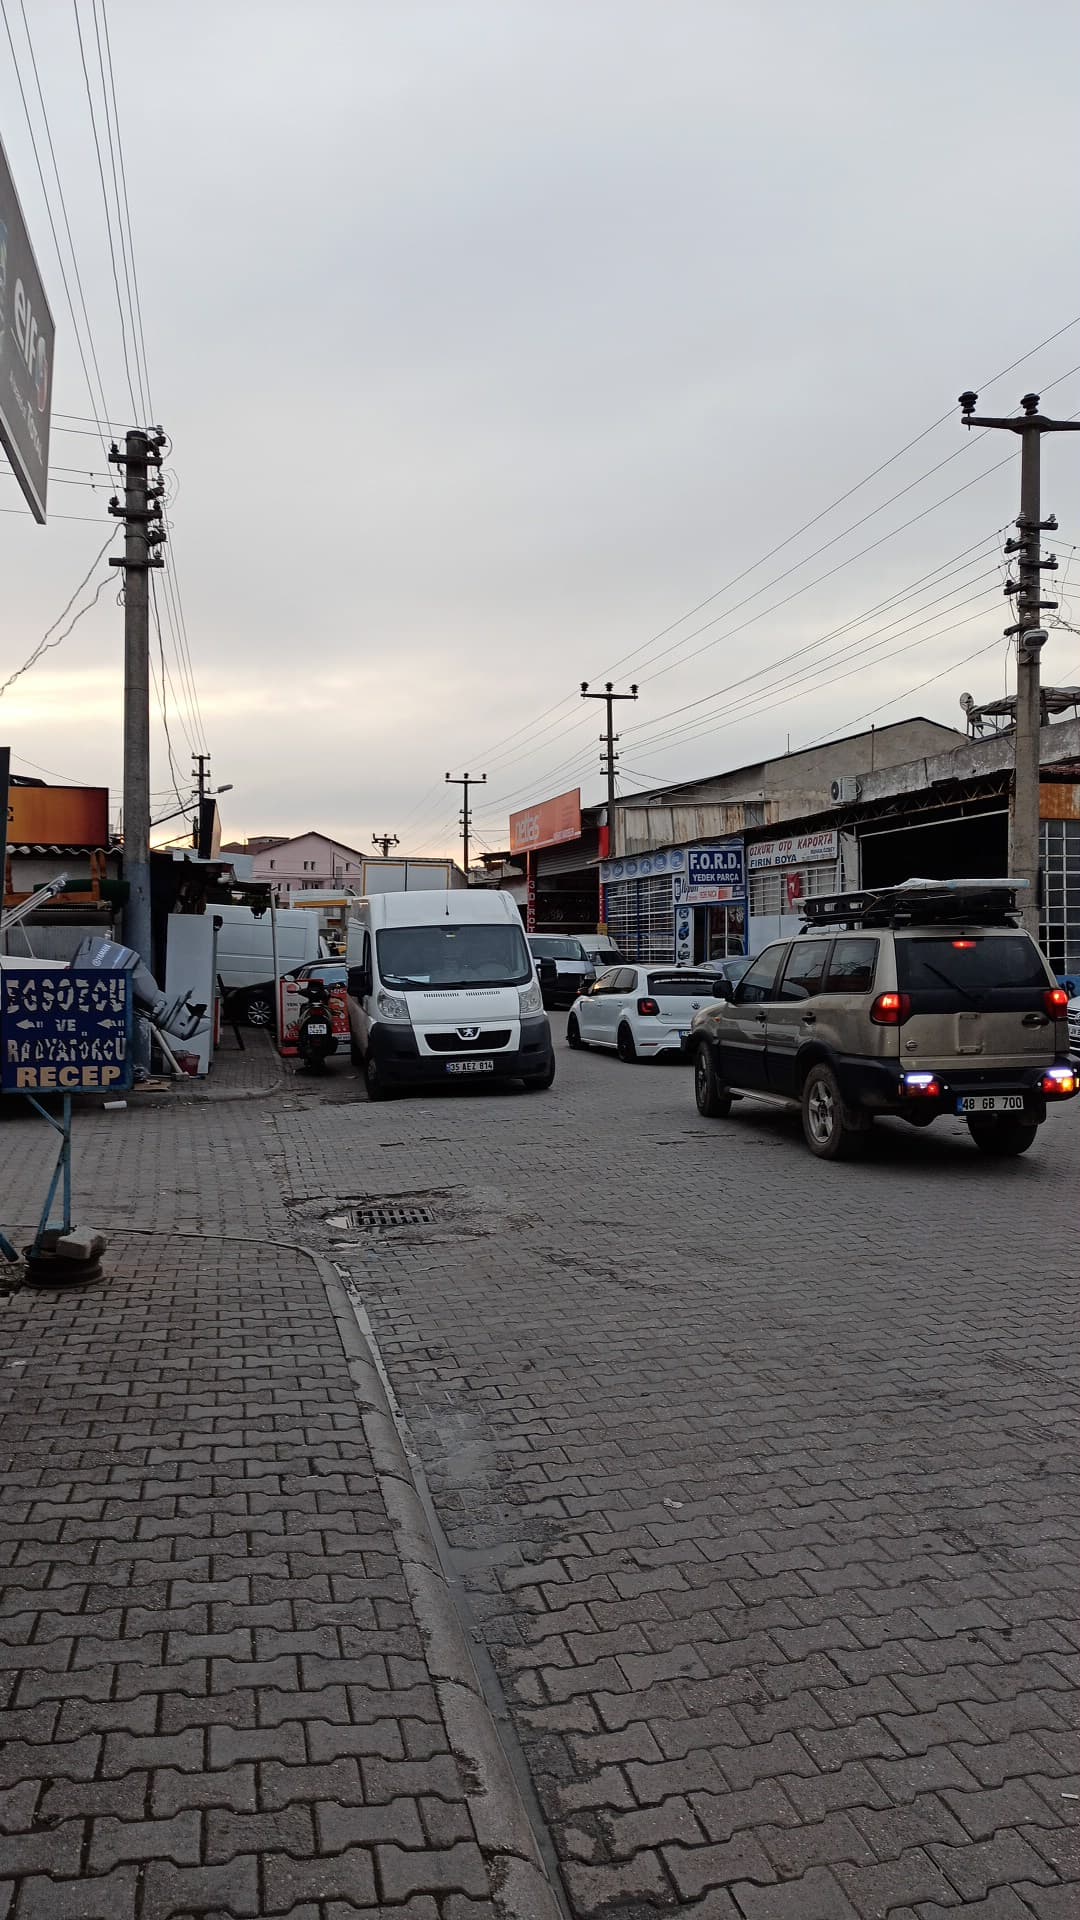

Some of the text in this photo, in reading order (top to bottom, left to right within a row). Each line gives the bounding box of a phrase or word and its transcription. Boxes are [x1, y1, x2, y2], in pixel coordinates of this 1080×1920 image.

[14, 278, 38, 377] elf
[778, 841, 792, 852] OTO
[797, 832, 833, 849] KAPORTA
[690, 853, 741, 870] F.O.R.D.
[750, 857, 772, 868] FIRIN
[775, 854, 797, 865] BOYA
[692, 873, 740, 883] YEDEK PARÇA
[55, 1019, 77, 1032] VE
[16, 1065, 121, 1088] RECEP
[963, 1096, 1021, 1110] 48 GB 700
